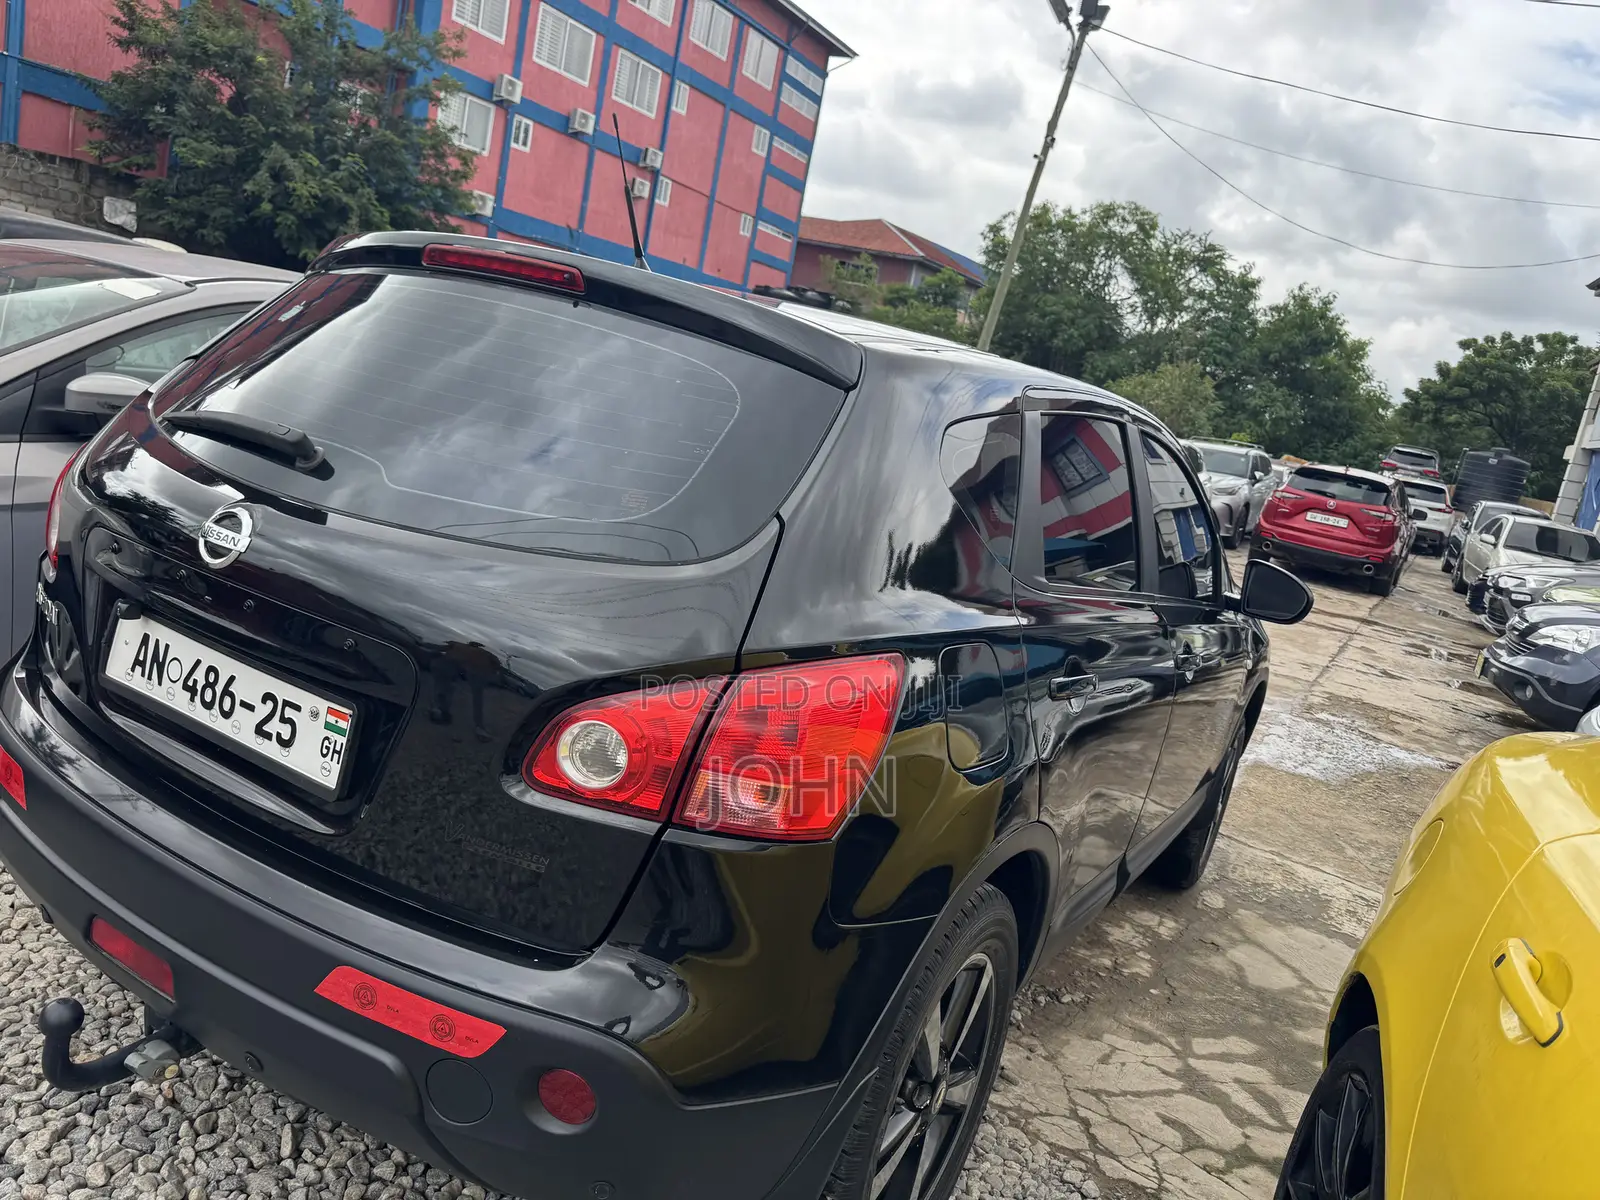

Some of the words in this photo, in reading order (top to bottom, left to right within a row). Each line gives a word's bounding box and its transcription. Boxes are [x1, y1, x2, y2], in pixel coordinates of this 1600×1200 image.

[201, 521, 241, 548] NISSAN
[131, 632, 170, 687] AN
[182, 658, 302, 748] 486-25
[320, 736, 344, 765] GH
[445, 820, 550, 865] VANDERMISSEN
